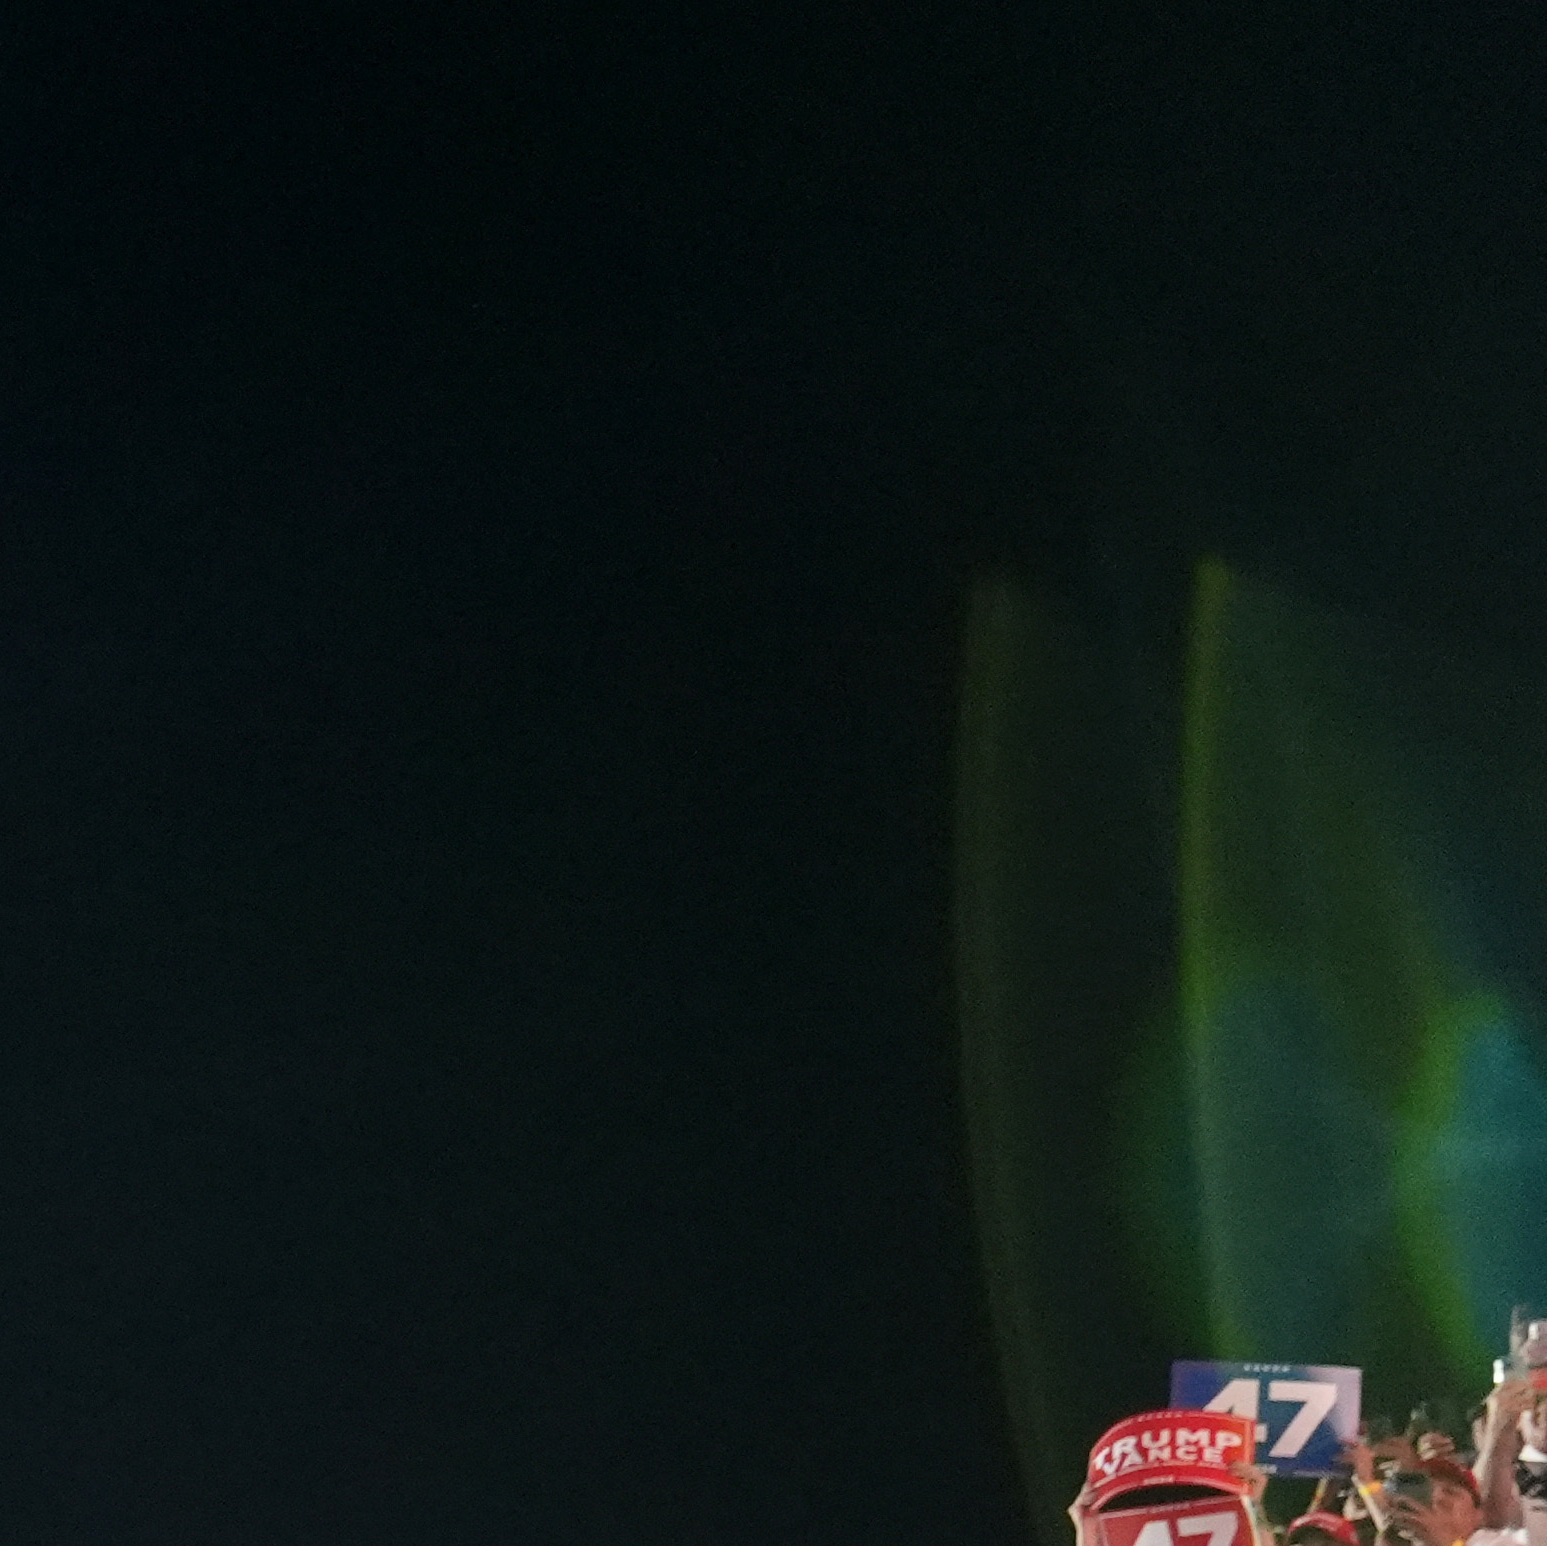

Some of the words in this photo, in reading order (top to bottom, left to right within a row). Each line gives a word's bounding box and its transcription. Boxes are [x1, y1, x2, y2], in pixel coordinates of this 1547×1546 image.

[1203, 1378, 1337, 1458] 47
[1093, 1427, 1243, 1470] TRUMP
[1102, 1445, 1225, 1475] VANCE
